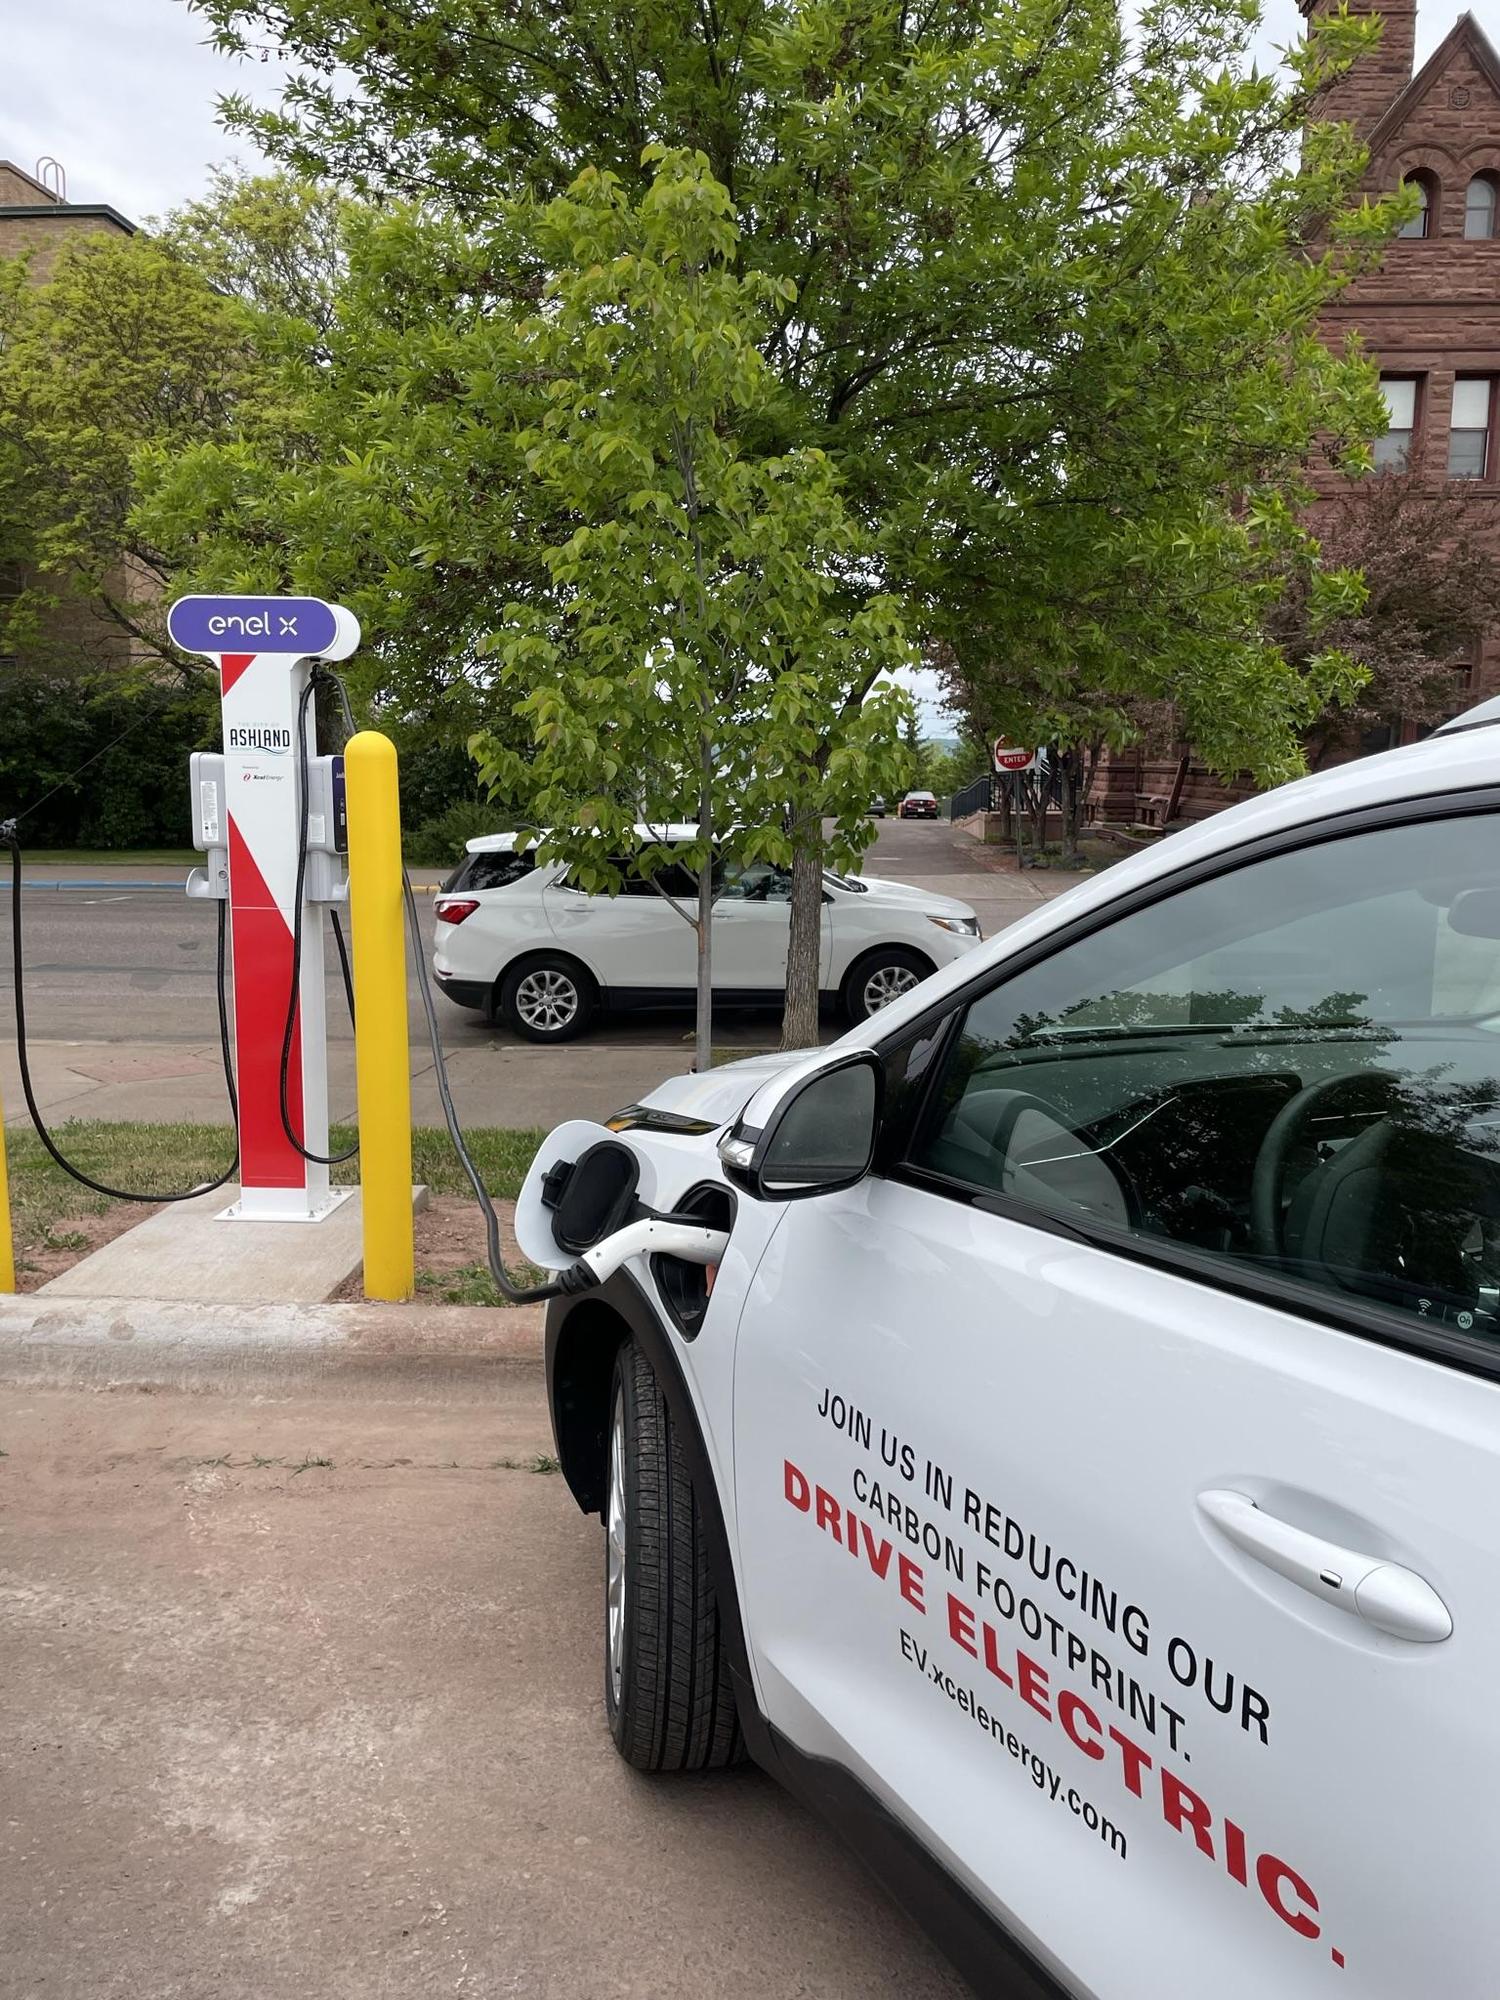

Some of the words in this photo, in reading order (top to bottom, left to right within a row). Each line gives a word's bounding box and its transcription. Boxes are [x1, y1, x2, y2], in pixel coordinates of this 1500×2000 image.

[208, 611, 271, 636] enel
[230, 728, 290, 747] ASHLAND
[1004, 755, 1026, 764] ENTER
[818, 1387, 872, 1450] JOIN
[881, 1428, 915, 1481] US
[925, 1460, 953, 1512] IN
[963, 1487, 1150, 1657] REDUCING
[1167, 1636, 1271, 1746] OUR
[853, 1468, 964, 1583] CARBON
[976, 1560, 1192, 1762] FOOTPRINT.
[784, 1458, 927, 1615] DRIVE
[946, 1591, 1345, 1969] ELECTRIC.
[899, 1627, 1128, 1860] EV.xcelenergy.com
